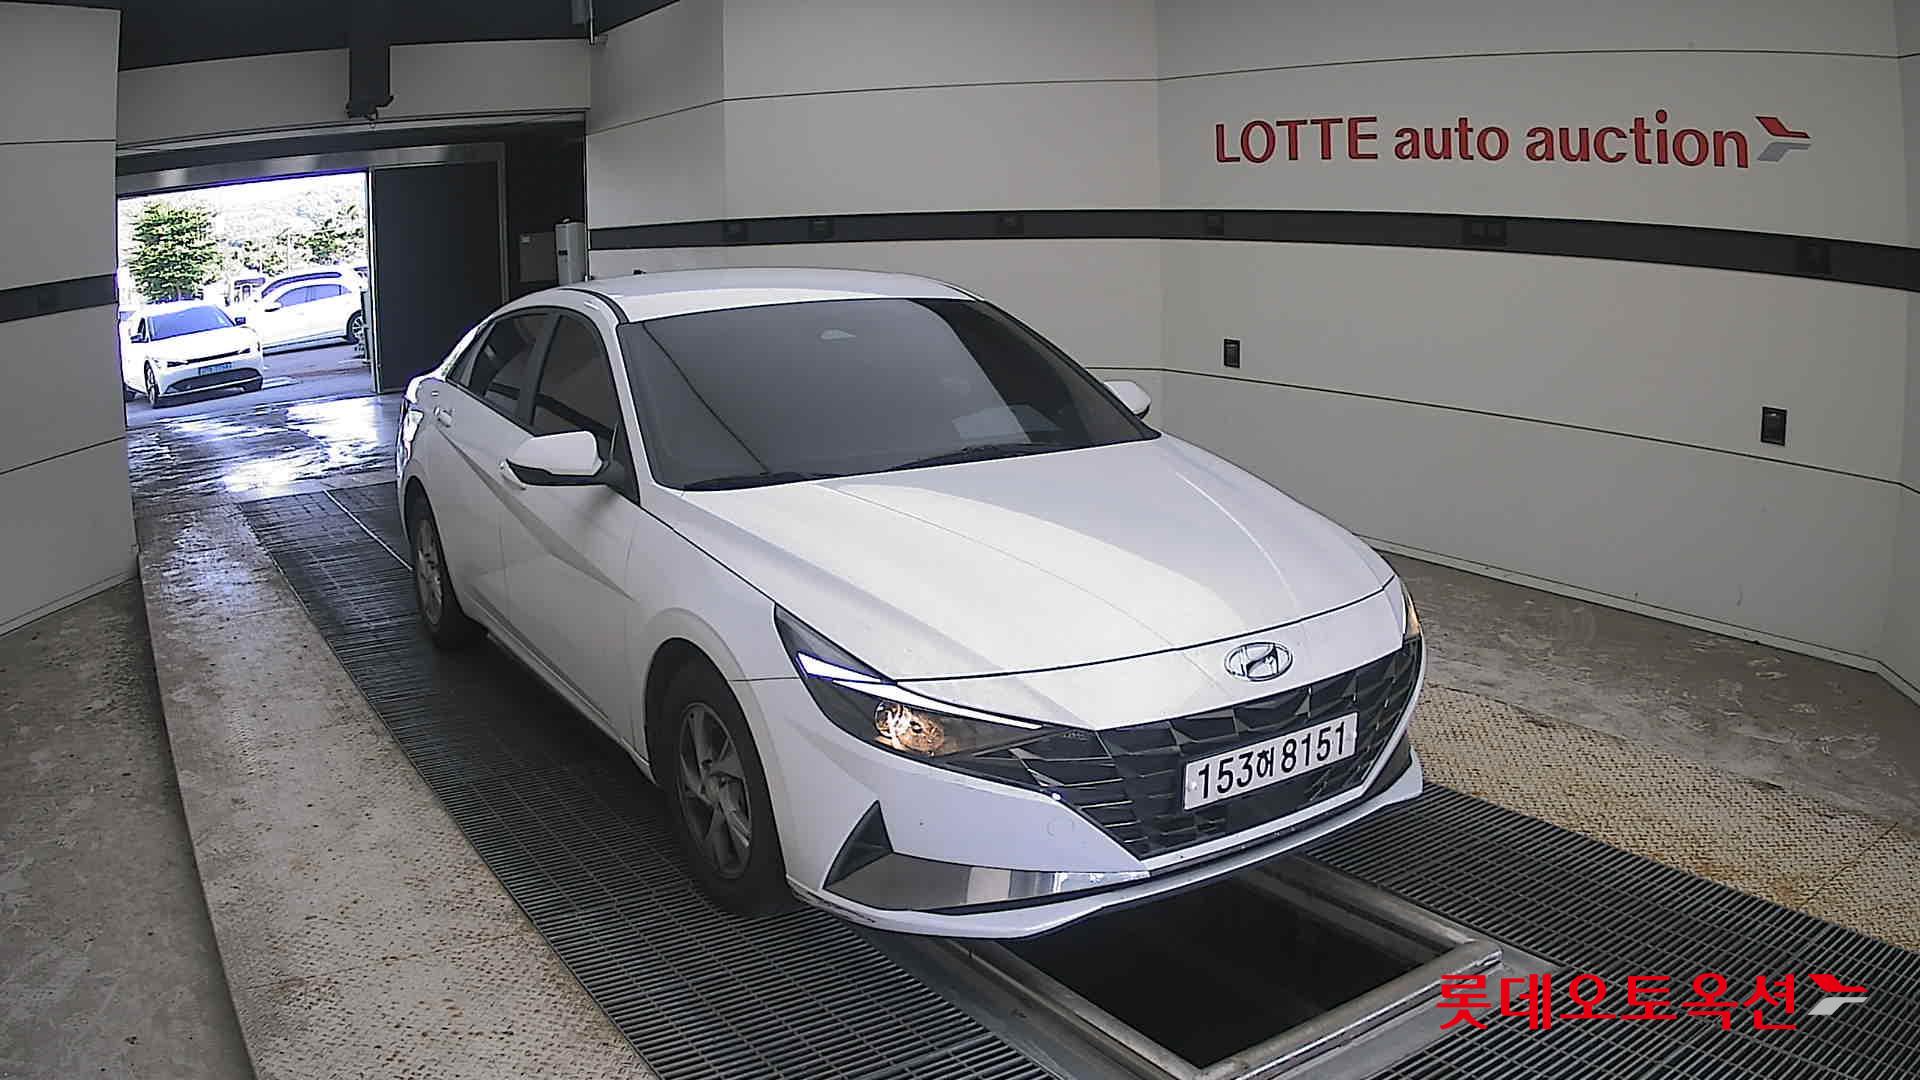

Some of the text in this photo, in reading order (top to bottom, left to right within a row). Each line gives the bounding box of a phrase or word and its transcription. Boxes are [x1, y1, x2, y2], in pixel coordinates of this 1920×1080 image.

[1214, 109, 1750, 169] LOTTE auto auction
